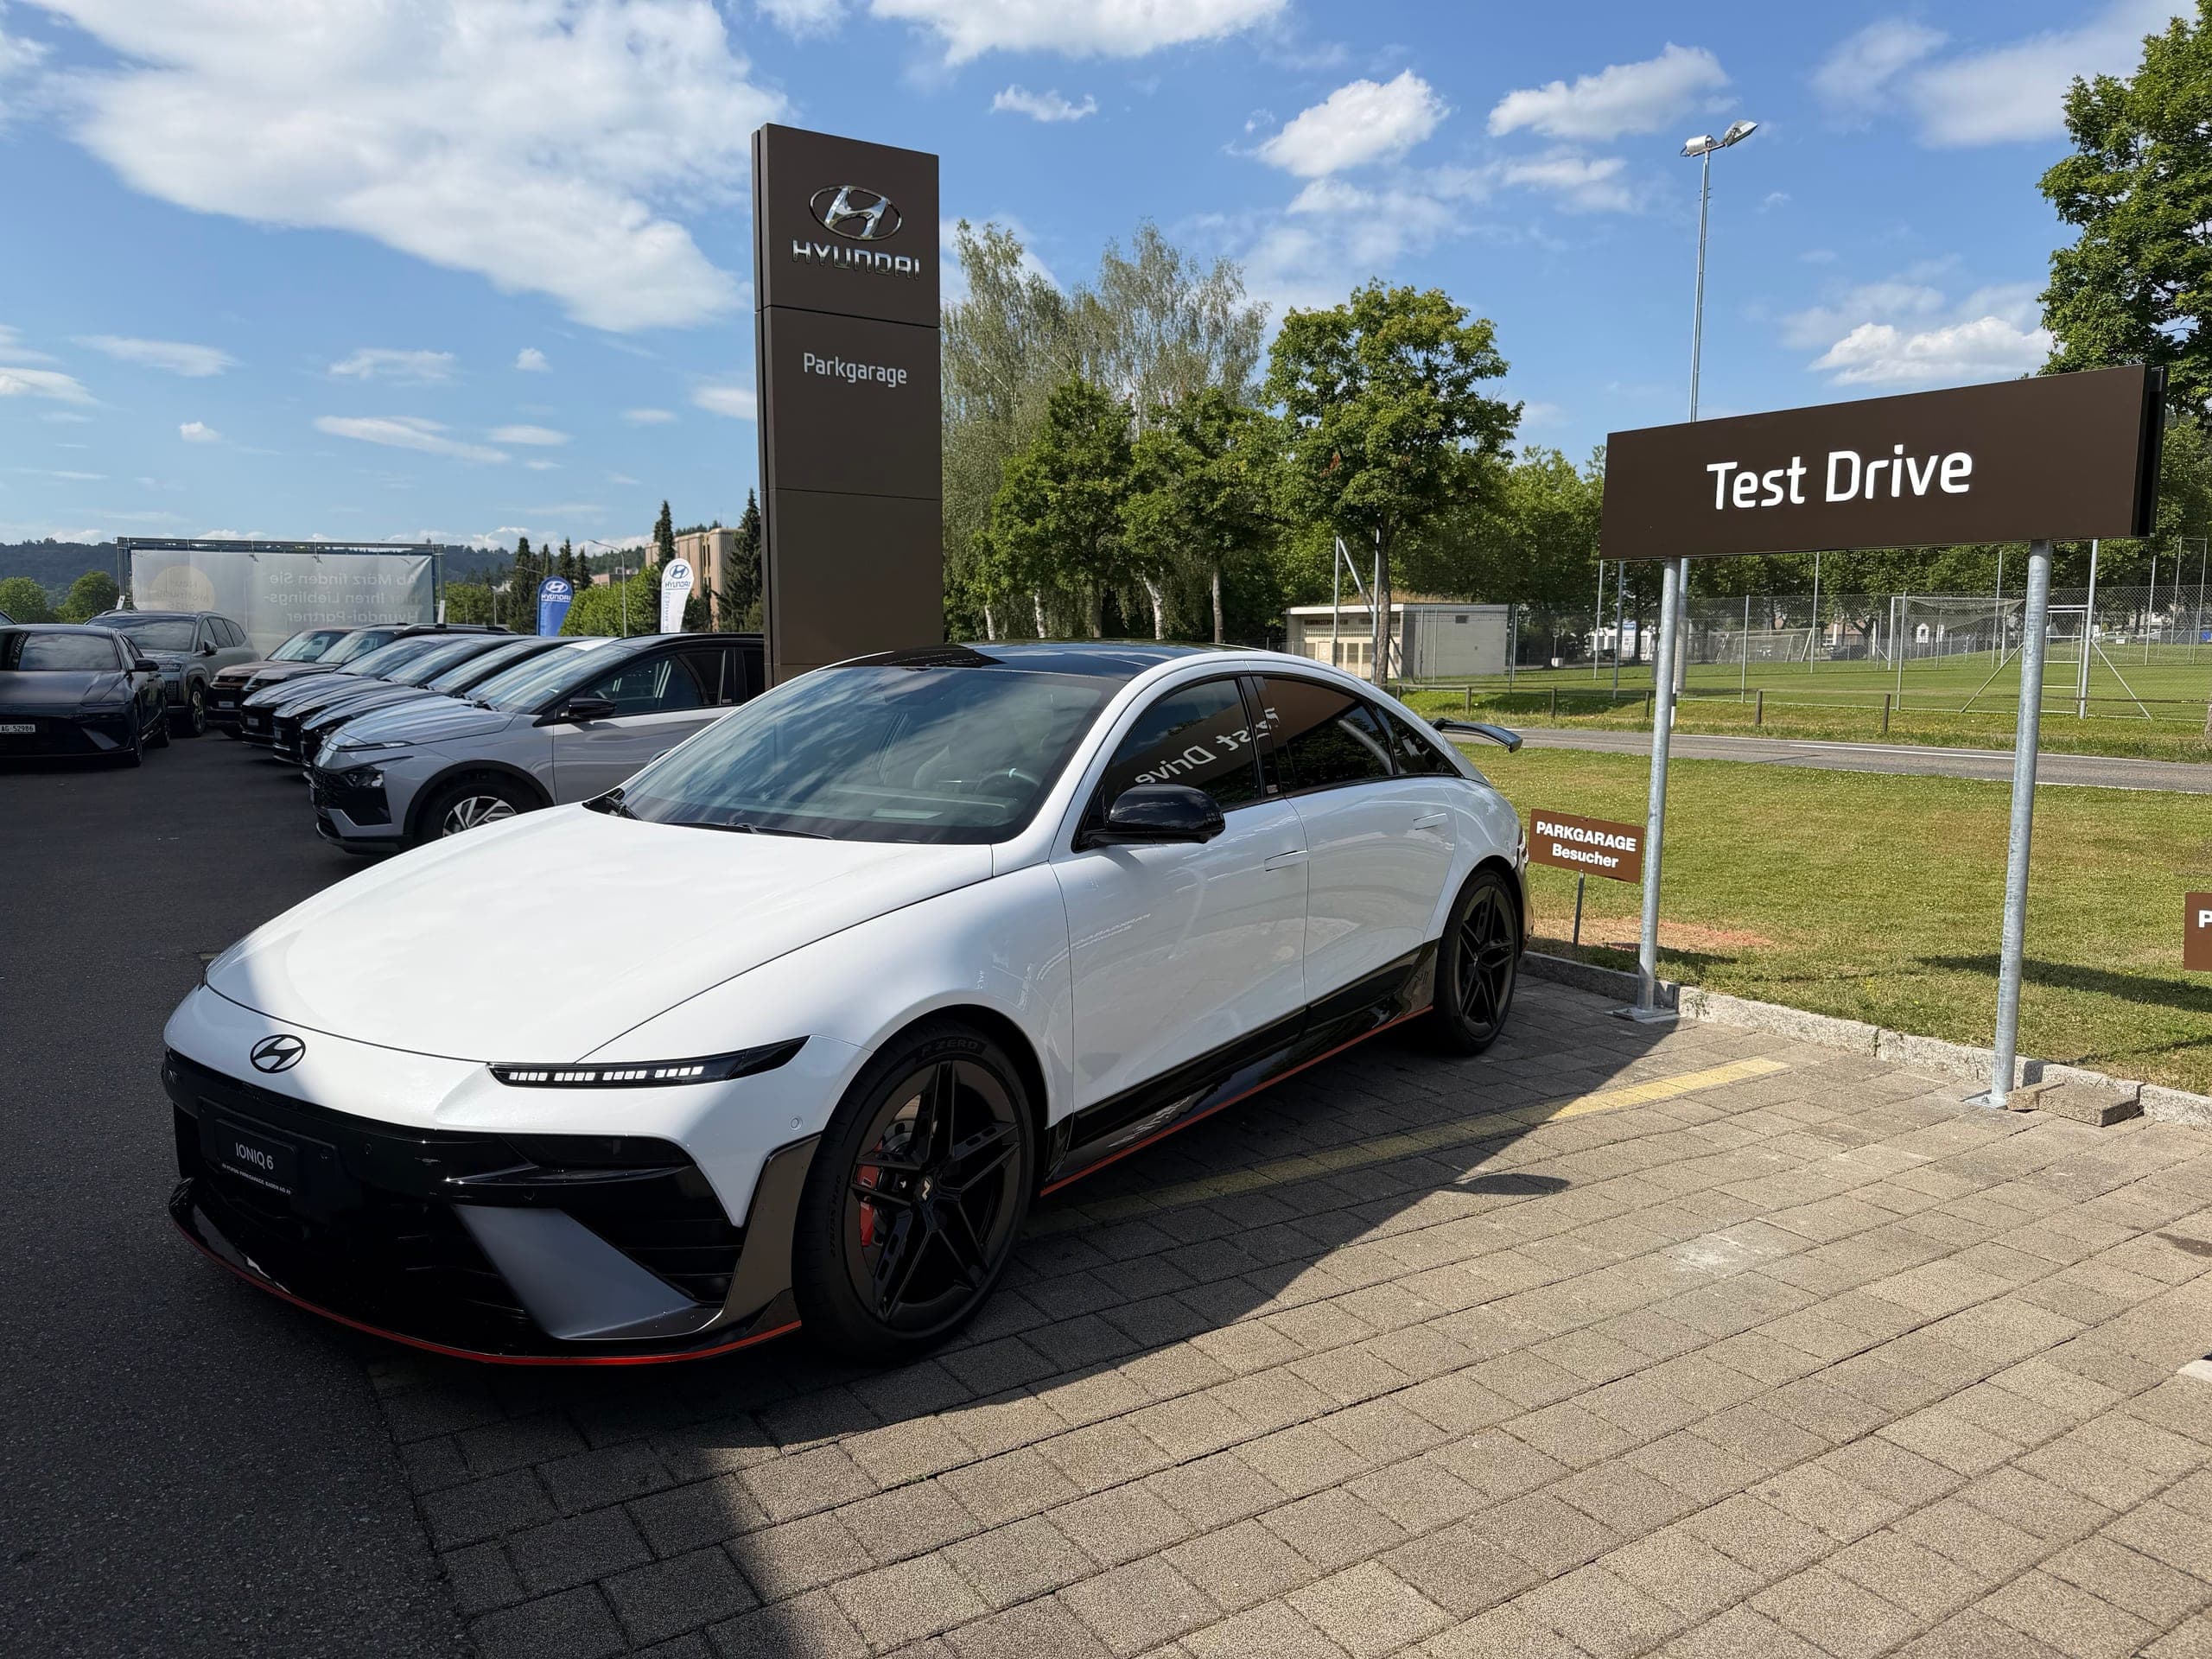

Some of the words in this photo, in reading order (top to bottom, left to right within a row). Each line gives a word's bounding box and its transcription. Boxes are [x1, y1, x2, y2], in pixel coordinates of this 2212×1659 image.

[791, 239, 921, 280] HYUNDAI
[803, 352, 908, 388] Parkgarage
[1707, 456, 1808, 510] Test
[1826, 444, 1974, 503] Drive
[541, 593, 571, 601] HYUNDAI
[1536, 821, 1637, 852] PARKGARAGE
[1552, 842, 1619, 868] Besucher
[235, 1141, 266, 1170] IONIQ
[266, 1154, 274, 1170] 6
